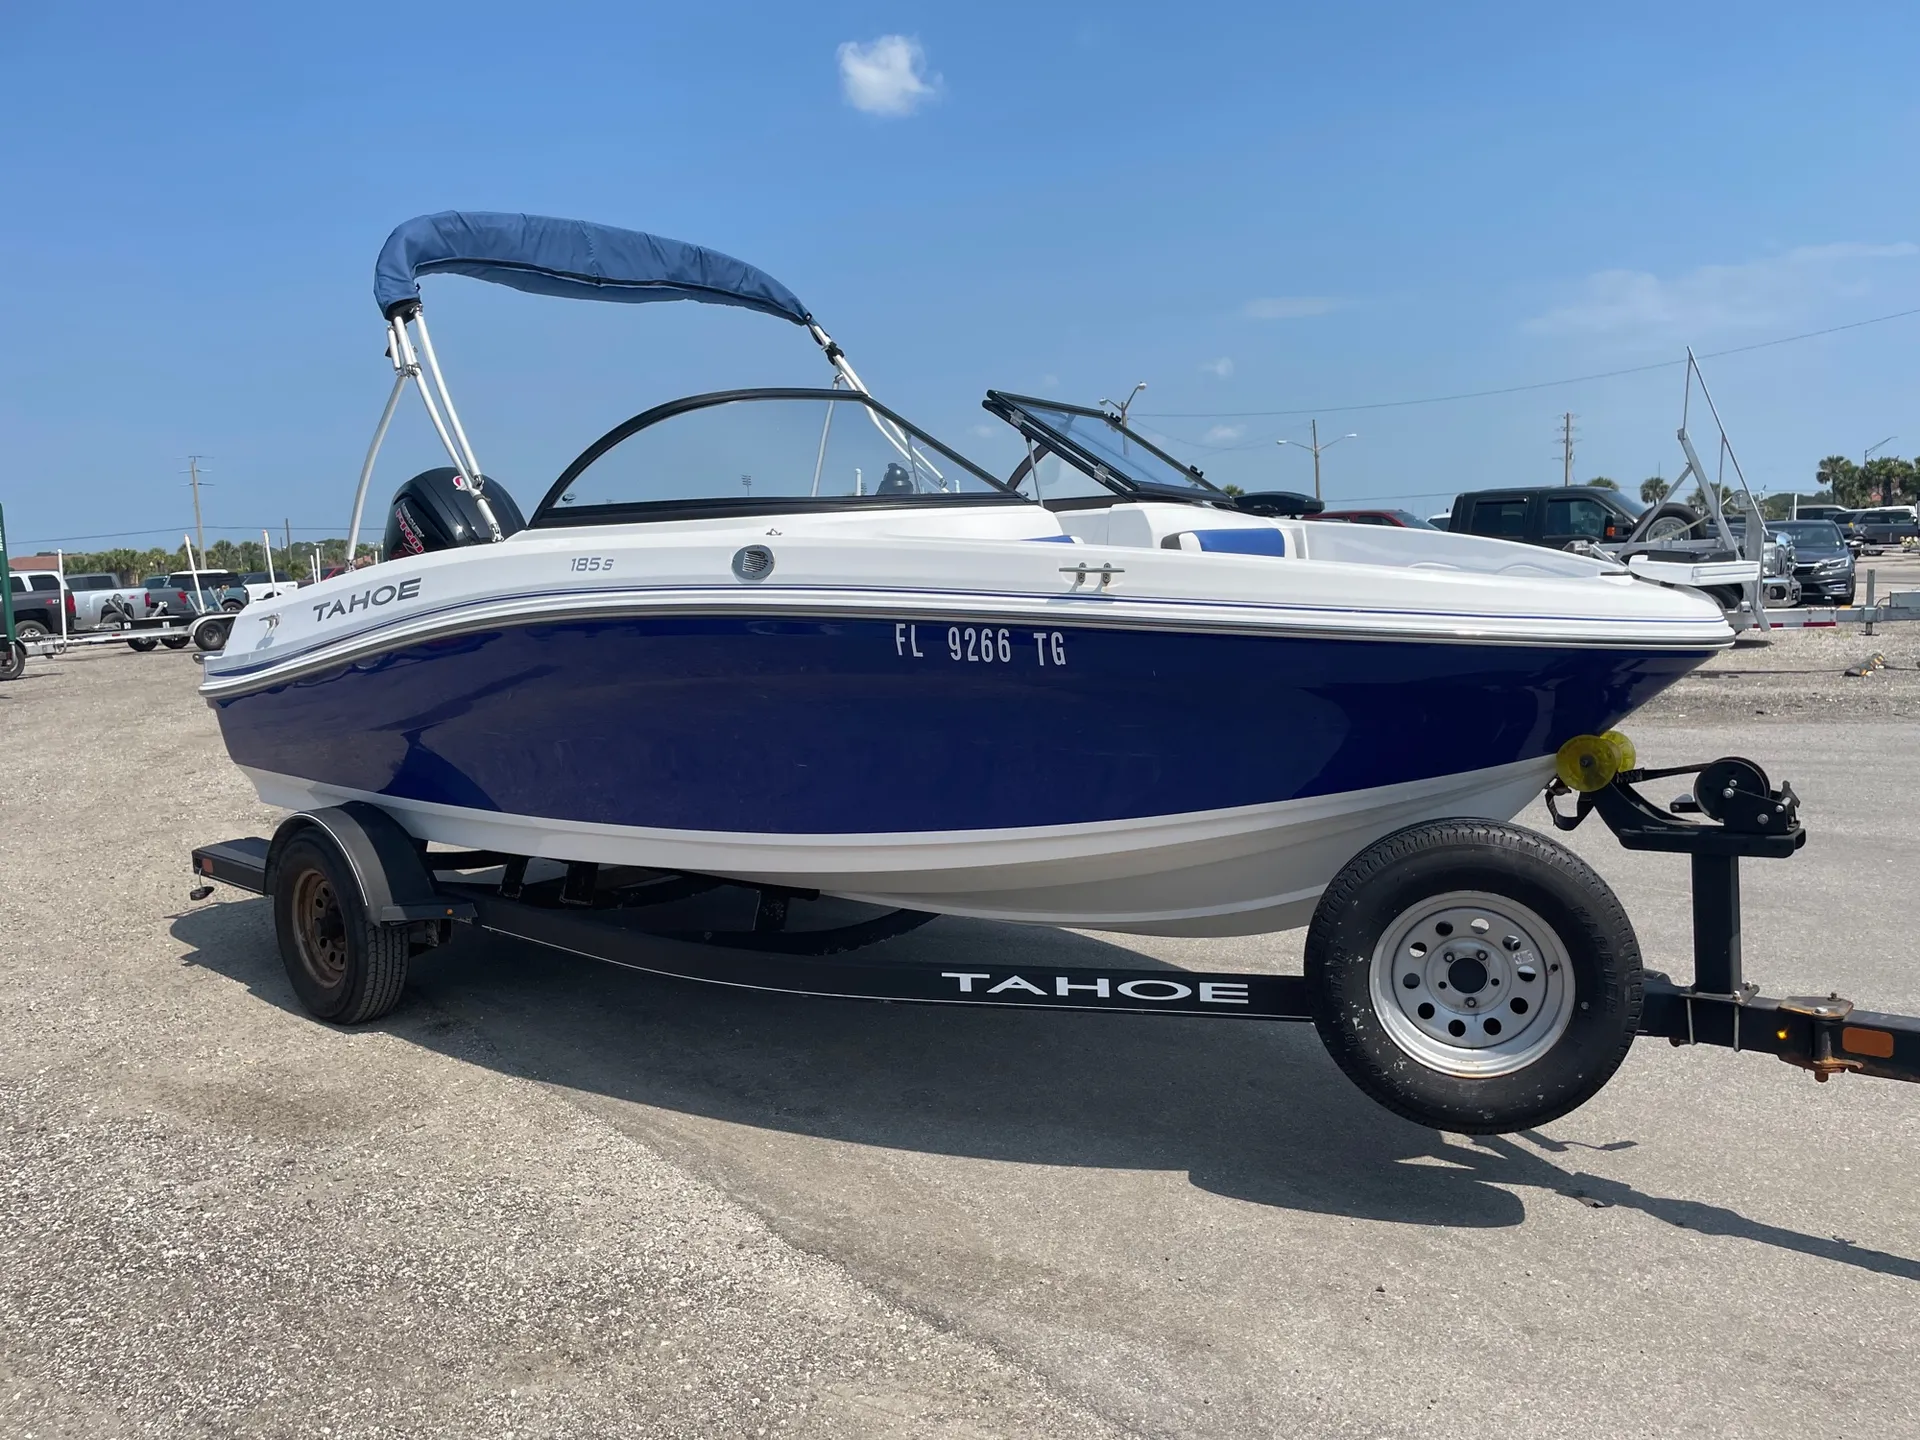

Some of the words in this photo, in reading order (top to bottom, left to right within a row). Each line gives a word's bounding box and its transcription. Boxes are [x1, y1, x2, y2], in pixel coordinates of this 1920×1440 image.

[571, 557, 602, 571] 185
[312, 577, 422, 622] TAHOE
[895, 623, 924, 658] FL
[947, 626, 1012, 663] 9266
[1033, 631, 1067, 666] TG
[941, 972, 1249, 1004] TAHOE
